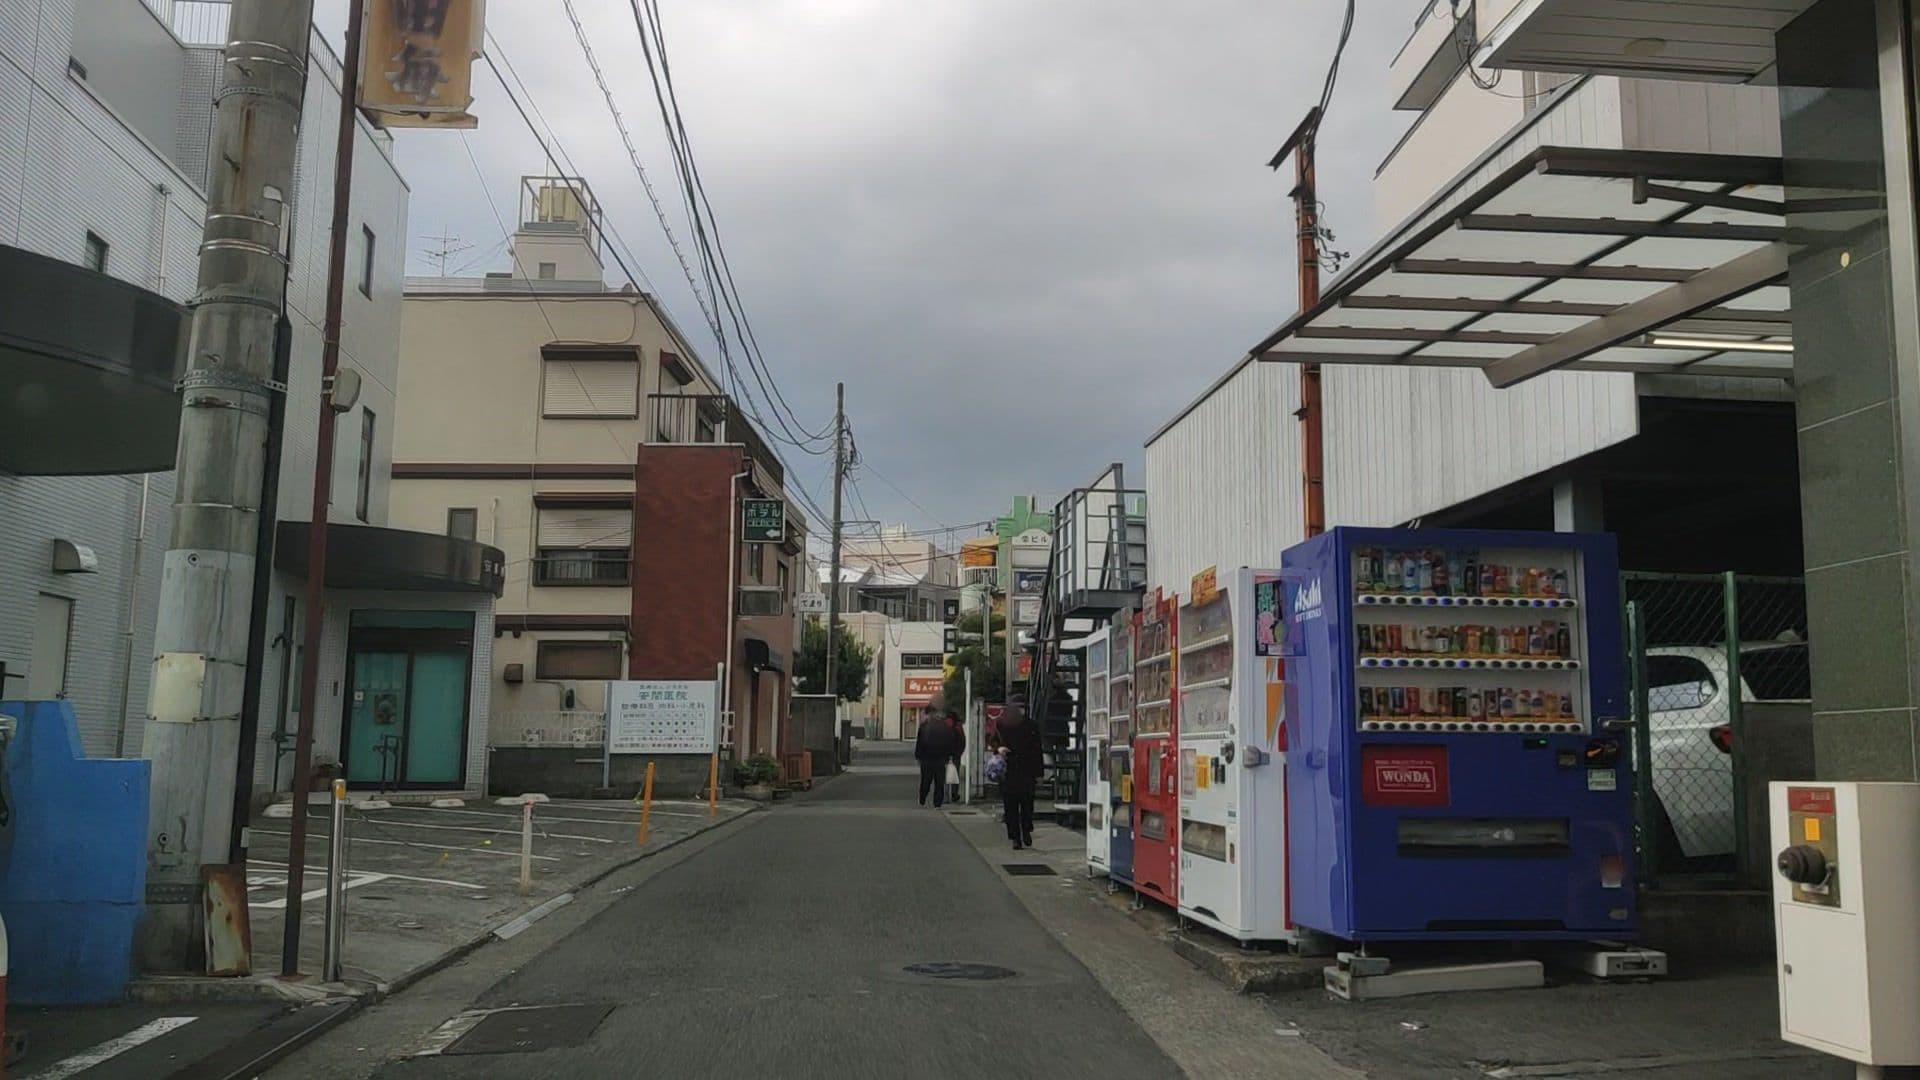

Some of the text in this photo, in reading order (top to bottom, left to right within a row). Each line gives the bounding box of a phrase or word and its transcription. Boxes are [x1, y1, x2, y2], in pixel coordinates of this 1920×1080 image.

[747, 509, 781, 517] ホテル
[1295, 577, 1321, 612] Asahi
[1383, 770, 1430, 783] WONDA
